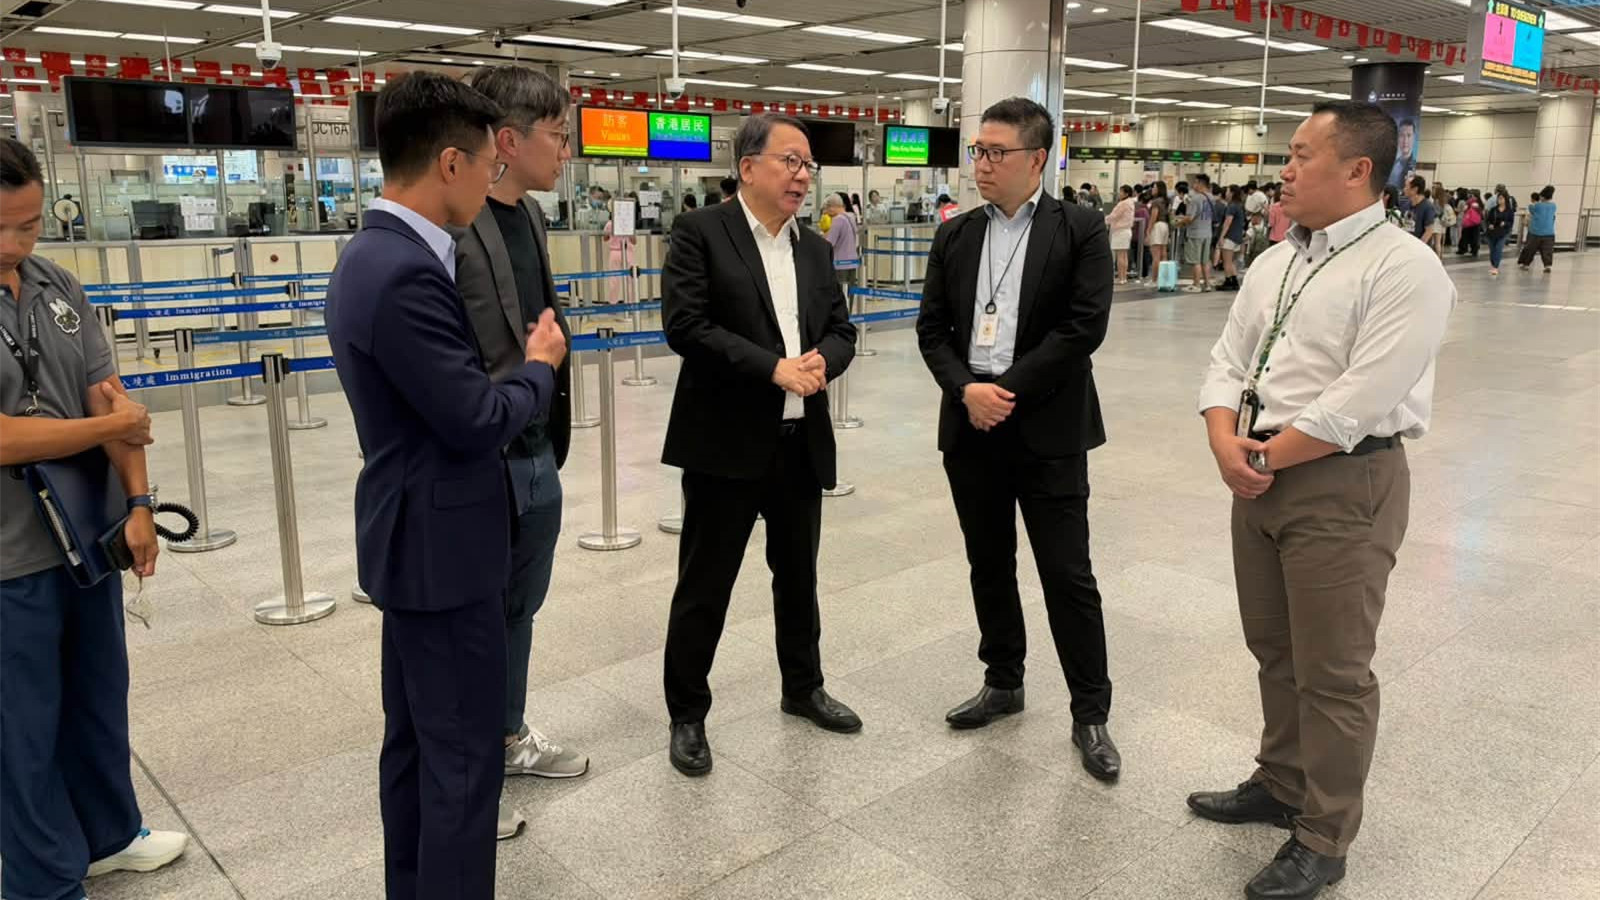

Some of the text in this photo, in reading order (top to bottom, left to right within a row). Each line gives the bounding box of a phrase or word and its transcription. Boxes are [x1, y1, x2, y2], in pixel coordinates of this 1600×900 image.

[602, 113, 628, 128] 訪客
[655, 116, 704, 133] 香港居民
[176, 305, 220, 315] Immigration
[165, 367, 233, 382] Immigration
